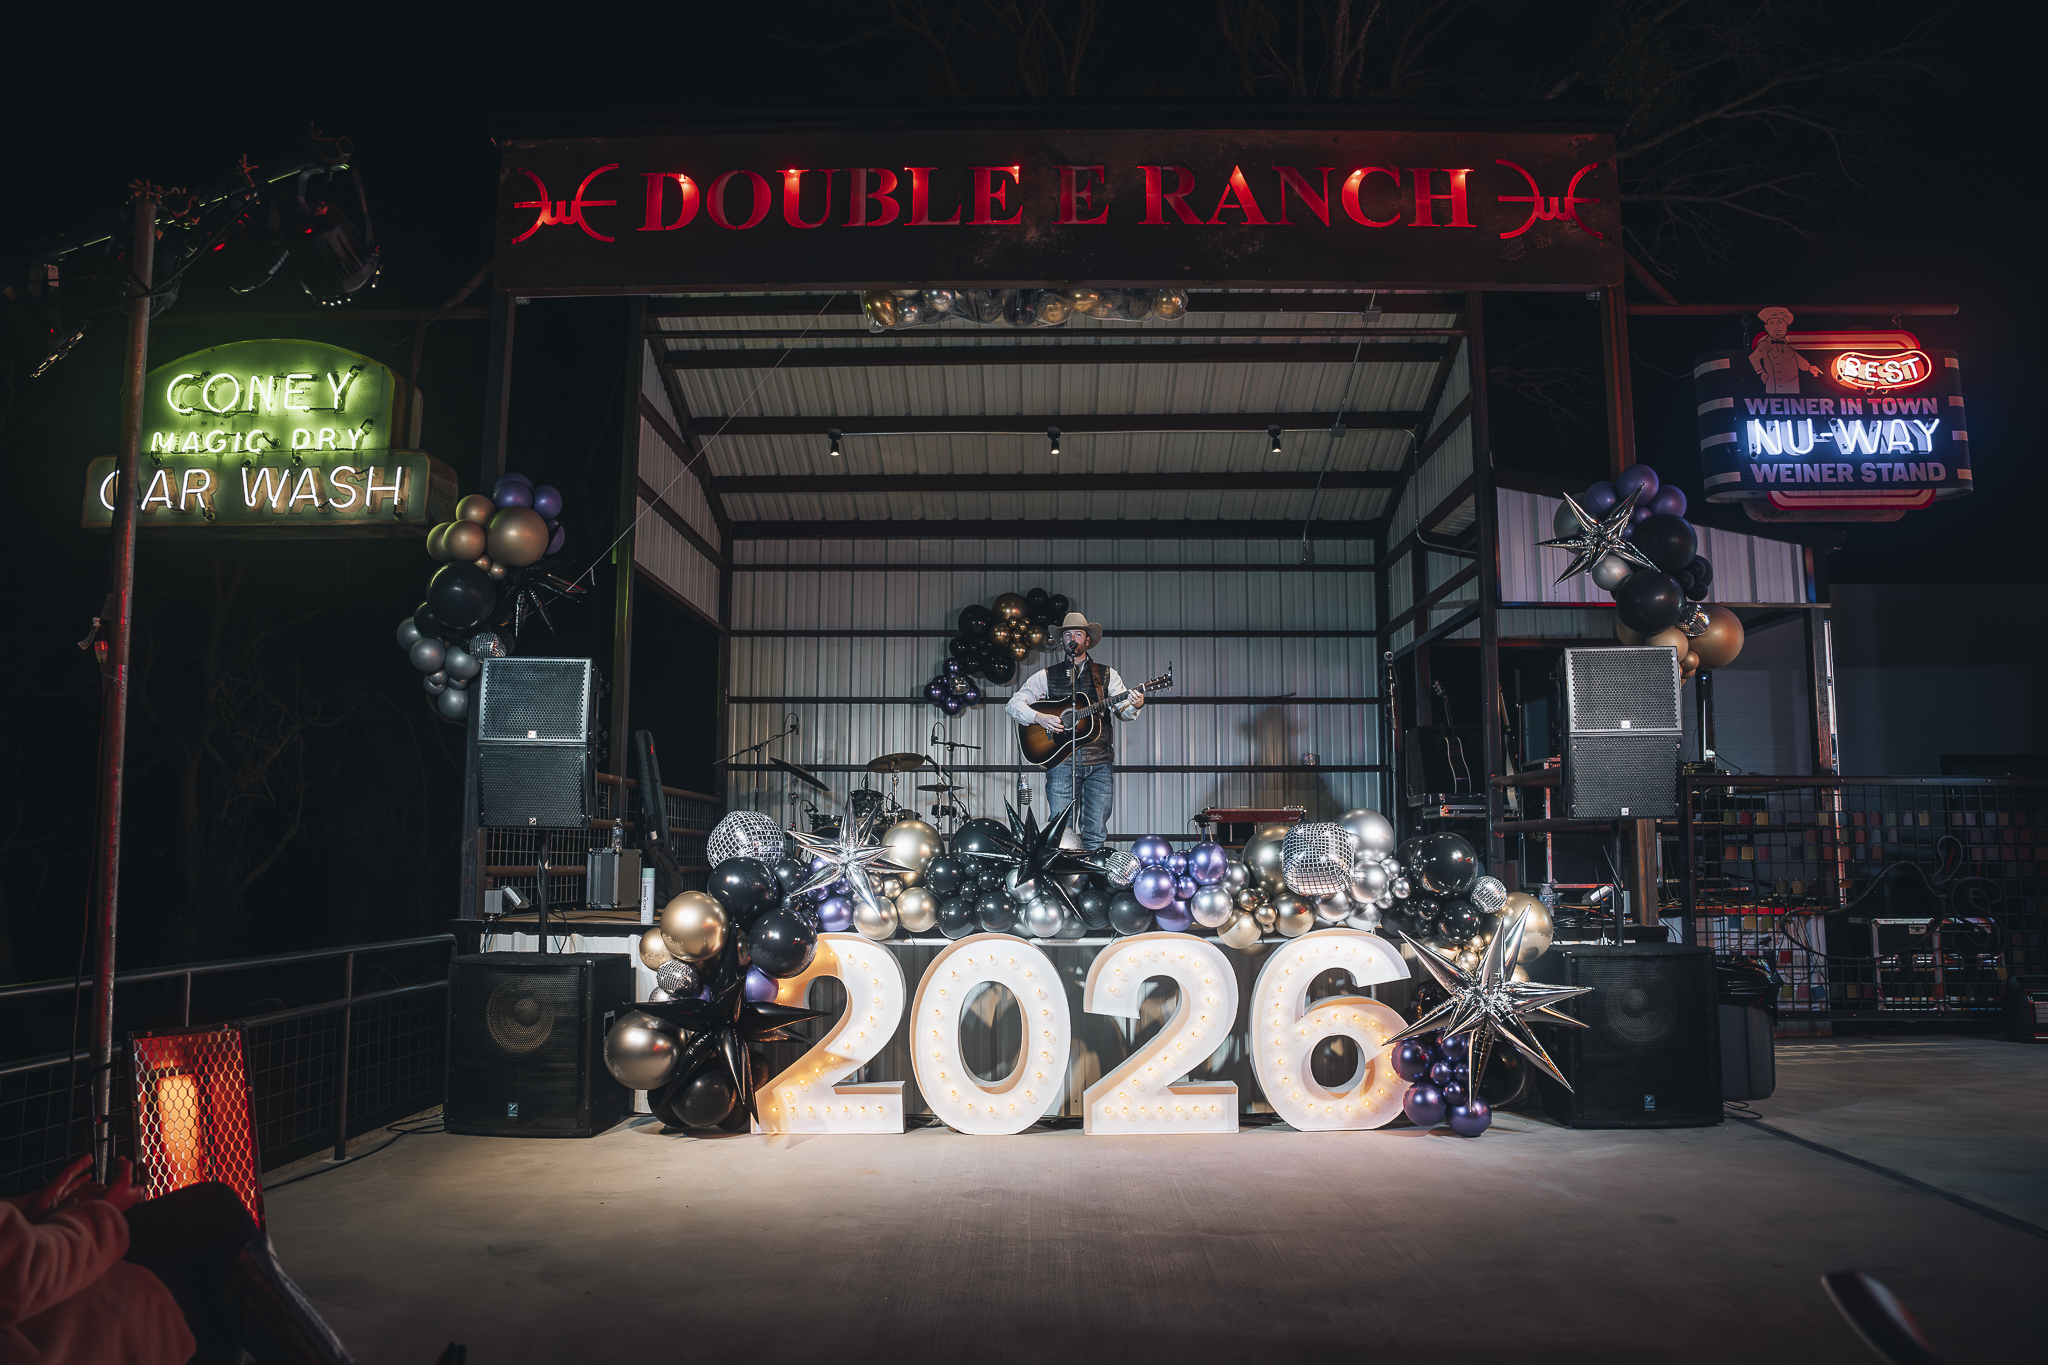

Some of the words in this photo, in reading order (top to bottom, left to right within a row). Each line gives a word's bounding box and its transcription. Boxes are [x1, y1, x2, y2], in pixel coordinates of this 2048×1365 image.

[636, 165, 1024, 231] DOUBLE
[1053, 166, 1109, 226] E
[1137, 166, 1478, 228] RANCH
[1840, 356, 1921, 384] BEST
[165, 366, 361, 416] CONEY
[1744, 397, 1834, 416] WEINER
[1841, 398, 1862, 416] IN
[1867, 397, 1938, 415] TOWN
[150, 429, 268, 454] MAGIC
[291, 427, 372, 453] DRY
[1746, 418, 1940, 456] NU-WAY
[239, 464, 413, 514] WASH
[1750, 463, 1854, 483] WEINER
[1860, 462, 1947, 482] STAND
[750, 930, 1412, 1136] 2026
